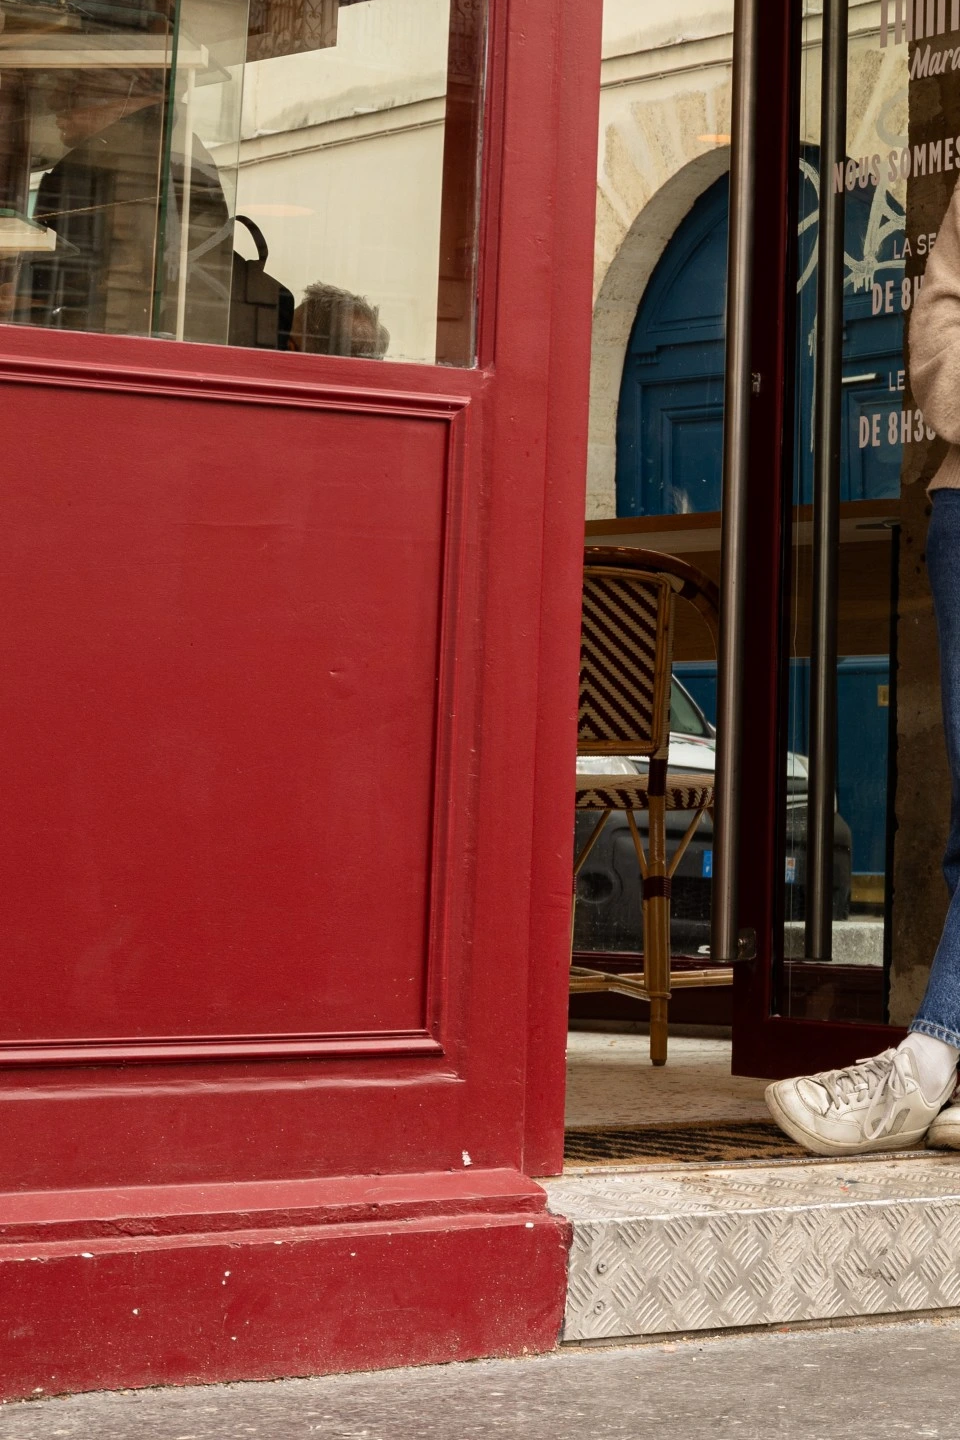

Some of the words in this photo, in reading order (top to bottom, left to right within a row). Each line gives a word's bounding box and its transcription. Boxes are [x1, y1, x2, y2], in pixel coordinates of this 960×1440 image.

[832, 153, 881, 195] NOUS
[893, 237, 913, 260] LA
[871, 280, 894, 317] DE
[888, 370, 905, 392] LE
[858, 413, 881, 449] DE
